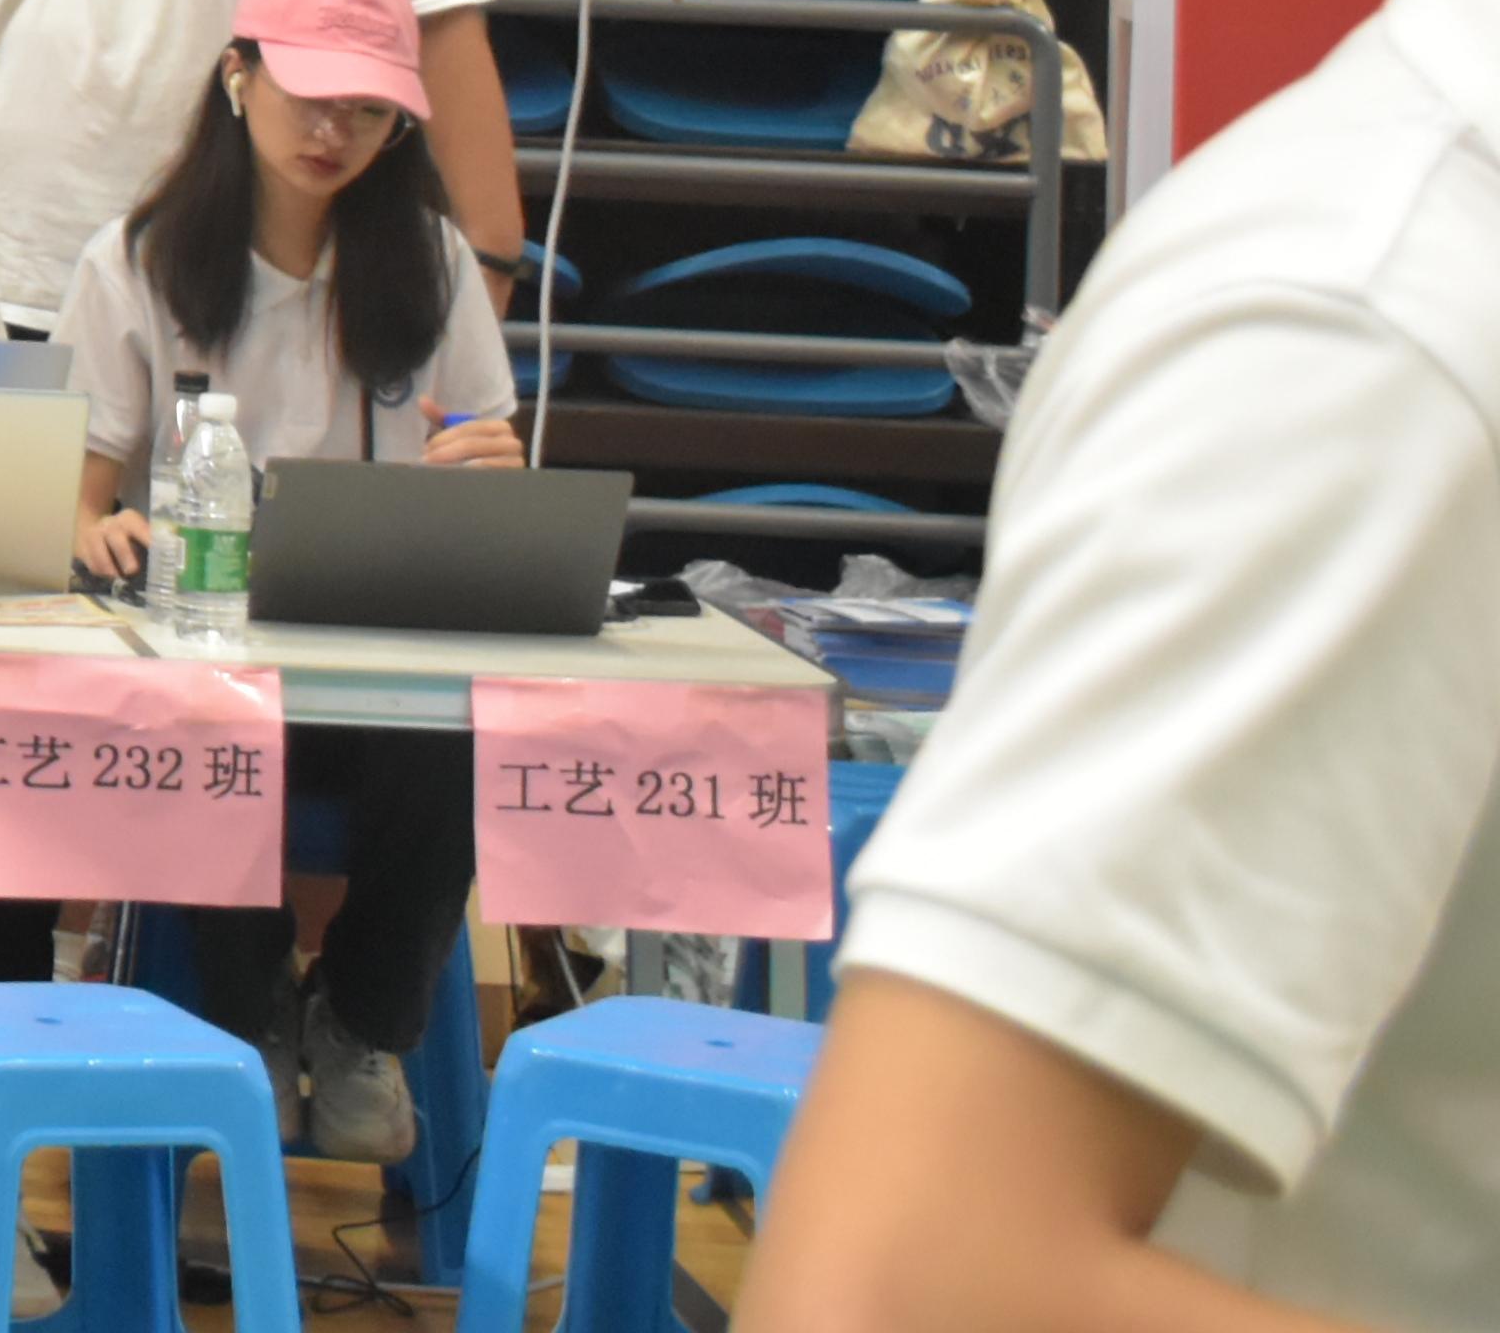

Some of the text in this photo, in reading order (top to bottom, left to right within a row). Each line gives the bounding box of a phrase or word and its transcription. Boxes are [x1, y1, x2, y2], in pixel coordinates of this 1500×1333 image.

[92, 744, 183, 791] 232
[203, 744, 263, 799] 班
[496, 761, 809, 828] 工艺 231 班
